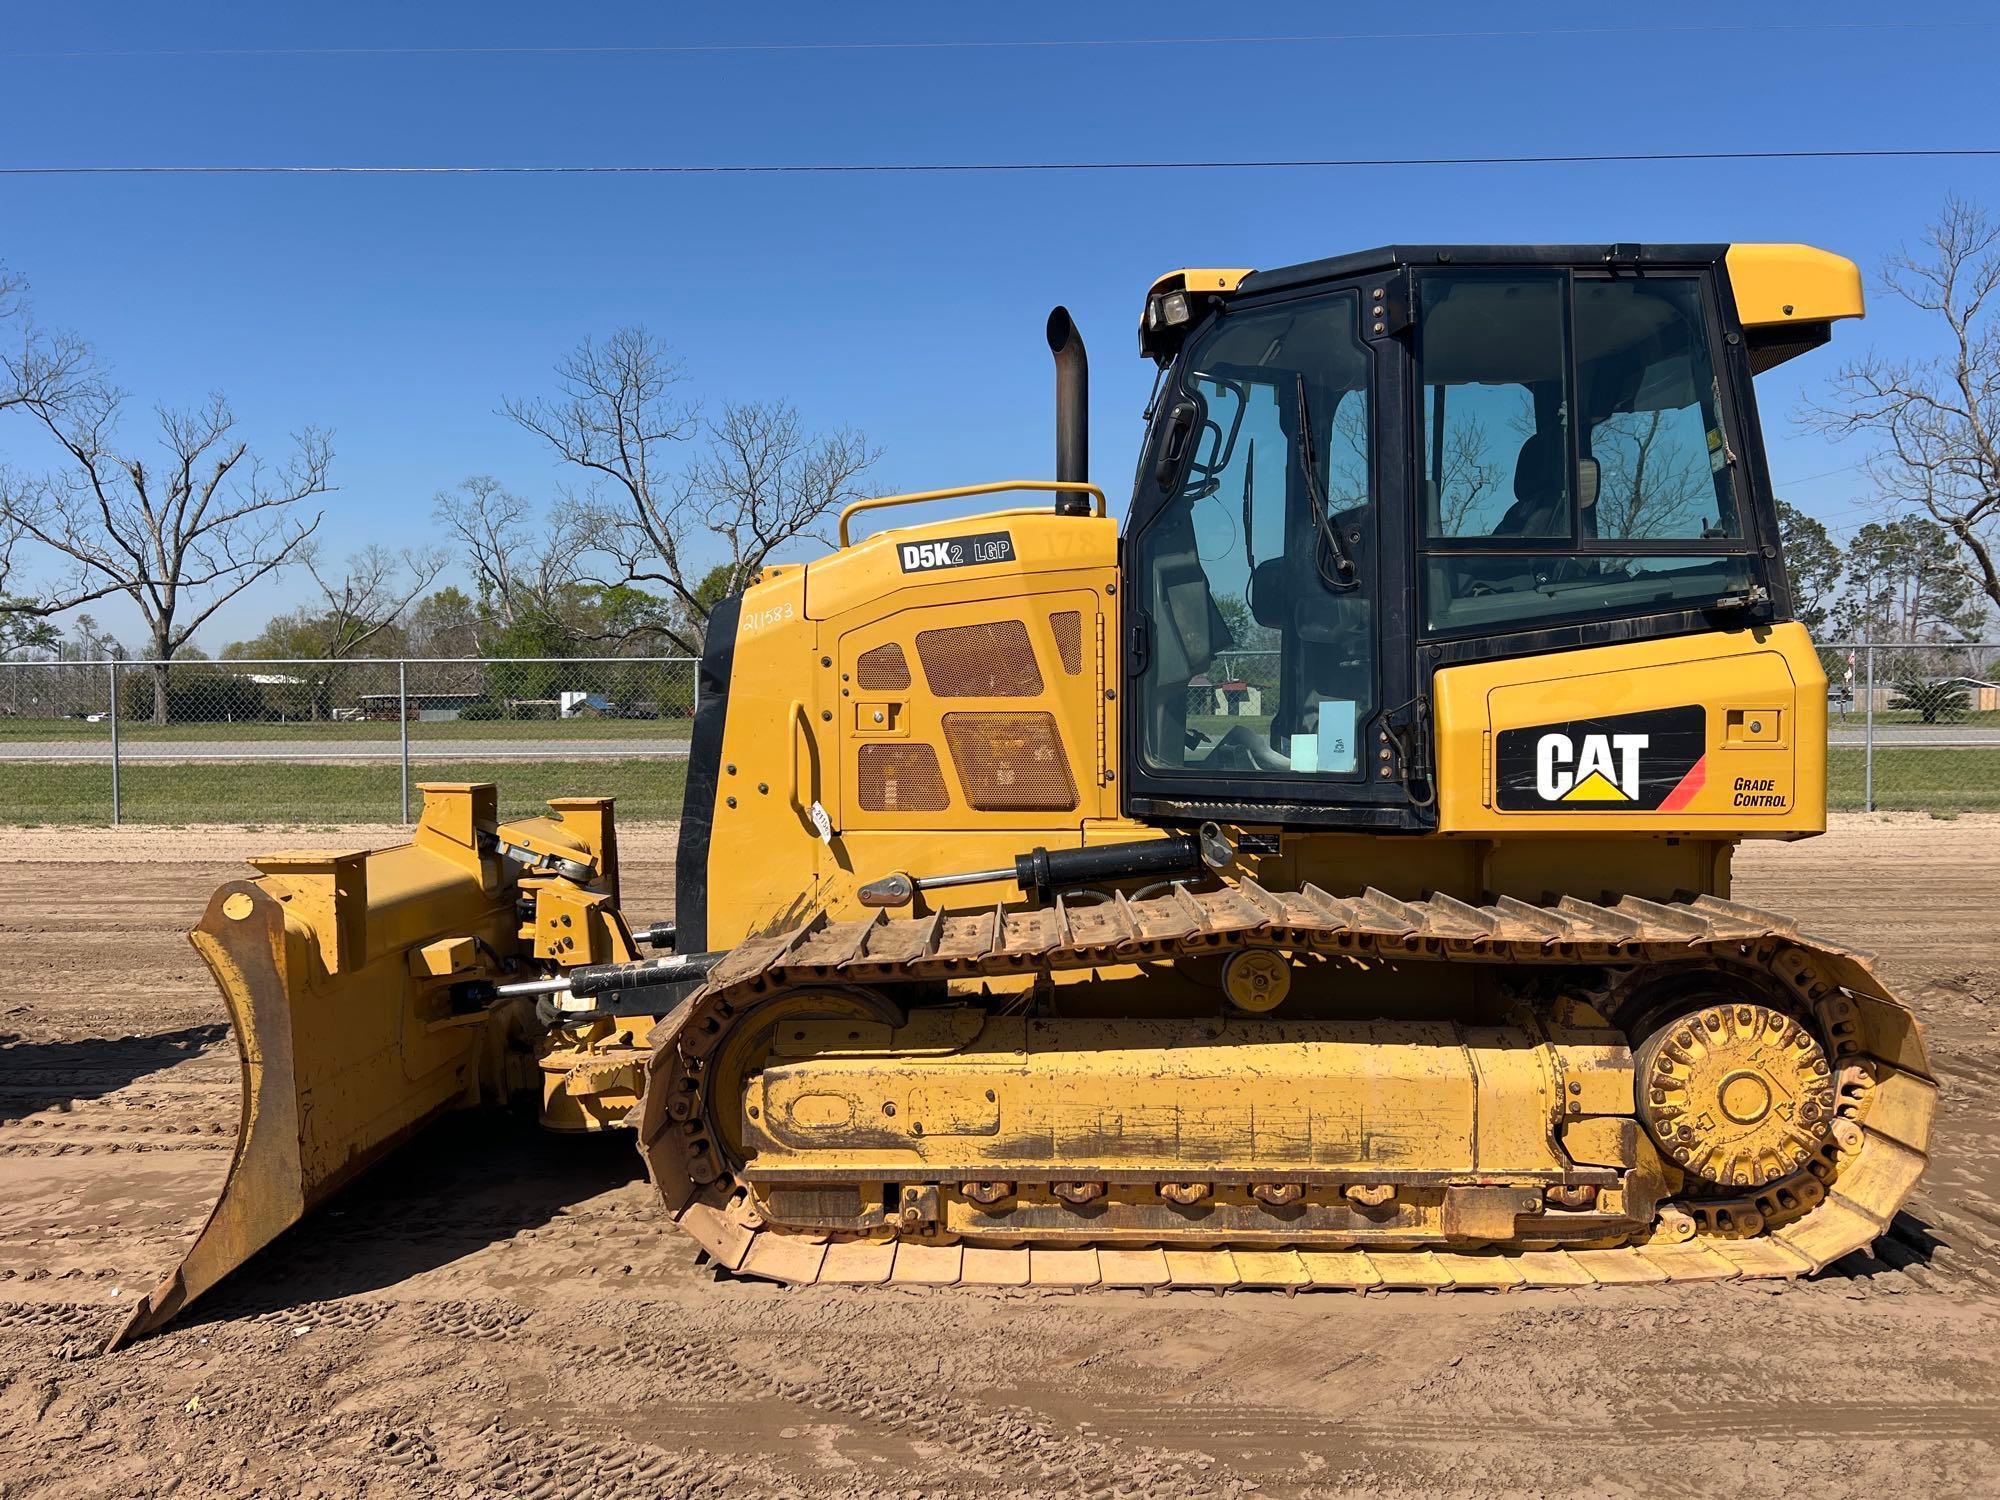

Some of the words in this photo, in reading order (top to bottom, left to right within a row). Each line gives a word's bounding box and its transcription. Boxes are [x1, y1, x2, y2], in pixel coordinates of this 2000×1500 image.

[903, 541, 964, 570] D5K2
[974, 540, 1010, 562] LGP
[743, 602, 793, 631] 211583
[1536, 733, 1649, 801] CAT
[1733, 777, 1775, 791] GRADE
[1733, 793, 1787, 807] CONTROL
